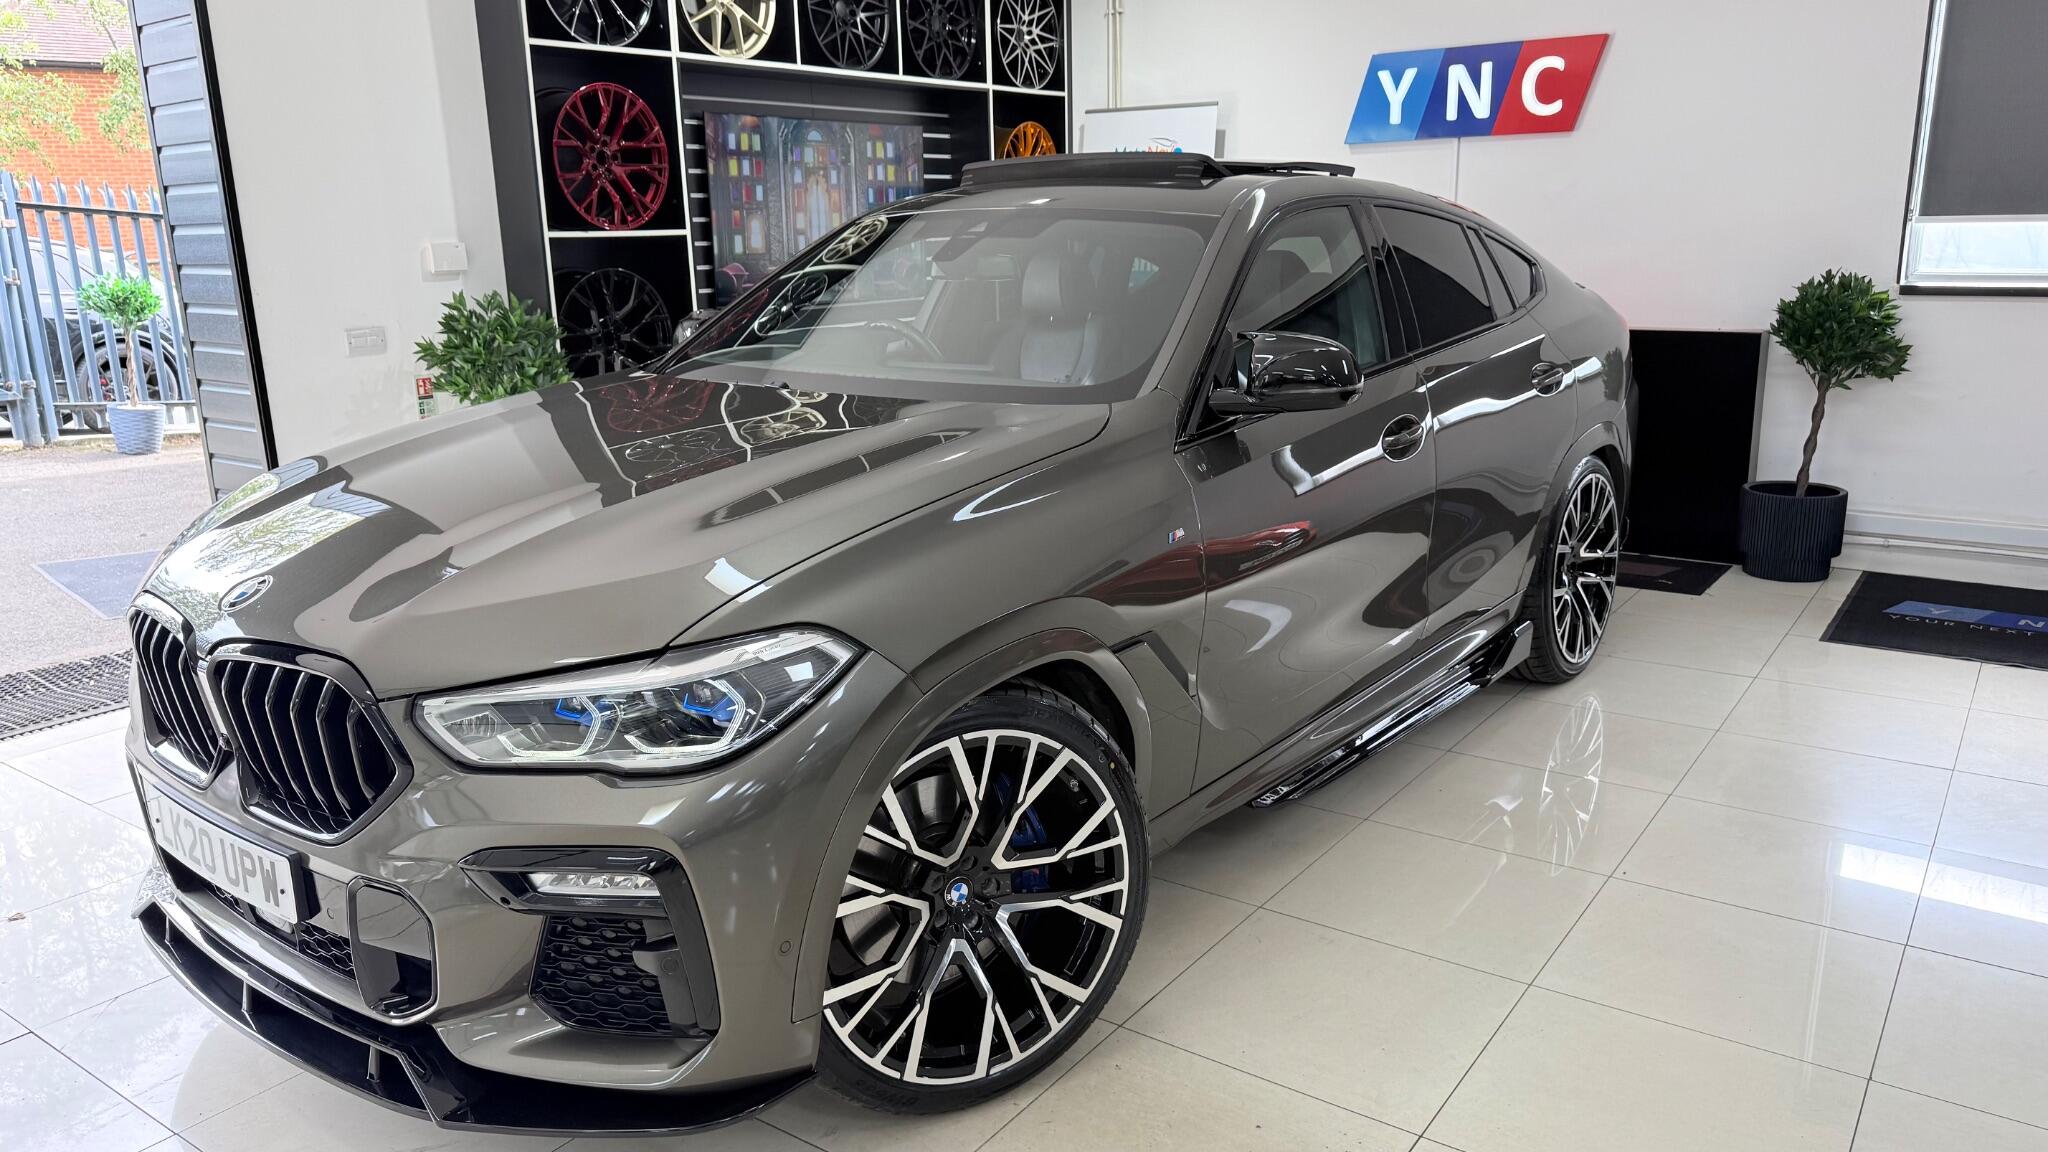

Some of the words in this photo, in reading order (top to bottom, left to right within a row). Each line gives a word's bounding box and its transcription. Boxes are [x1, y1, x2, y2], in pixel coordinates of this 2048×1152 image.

[1377, 55, 1565, 125] YNC
[1889, 614, 1955, 626] YOUR
[1969, 624, 2035, 636] NEXT
[157, 799, 217, 875] LK20
[219, 838, 280, 908] UPW
